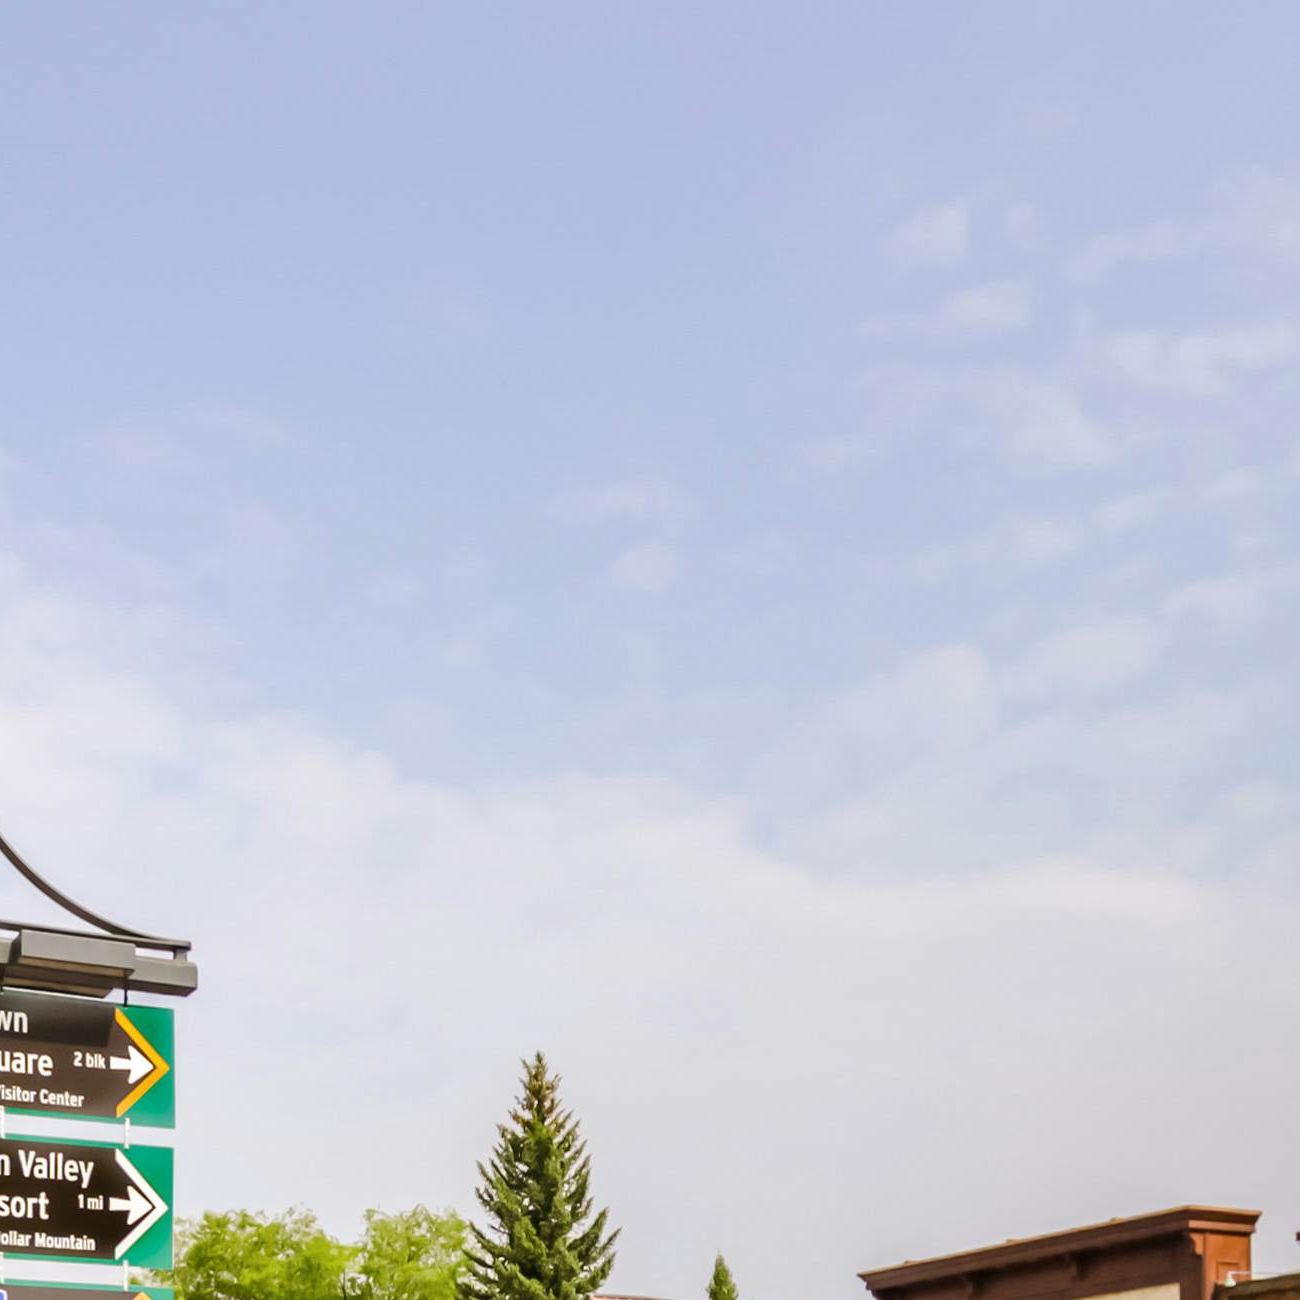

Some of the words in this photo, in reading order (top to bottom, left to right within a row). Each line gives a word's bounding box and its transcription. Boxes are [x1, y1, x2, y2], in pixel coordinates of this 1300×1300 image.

[73, 1051, 83, 1067] 2
[85, 1052, 106, 1069] blk
[39, 1088, 85, 1108] Center
[18, 1149, 95, 1189] Valley
[77, 1193, 84, 1209] 1
[87, 1195, 104, 1211] mi
[34, 1232, 96, 1251] Mountain
